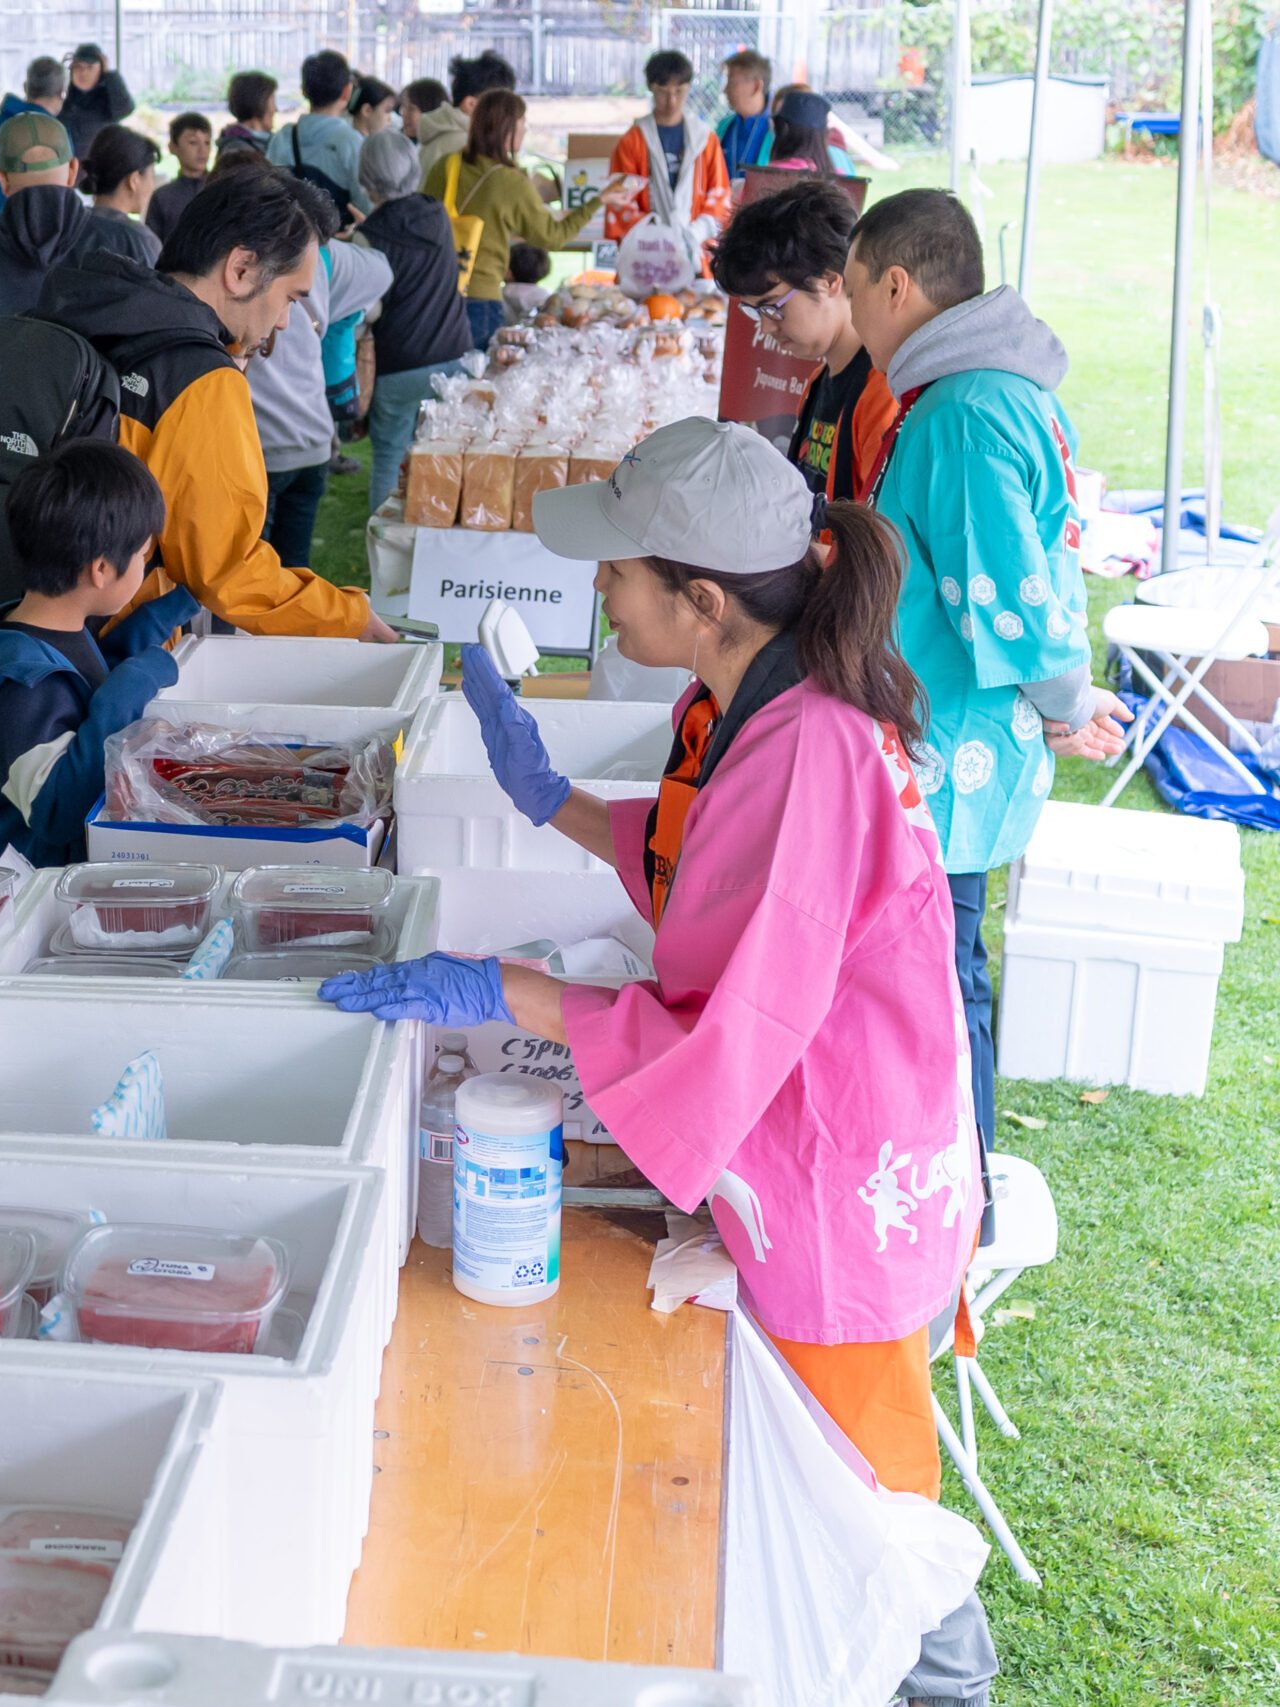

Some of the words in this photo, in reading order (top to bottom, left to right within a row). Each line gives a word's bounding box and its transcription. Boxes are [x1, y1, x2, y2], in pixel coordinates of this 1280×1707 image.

[440, 579, 563, 604] Parisienne
[300, 1671, 384, 1700] UNI
[410, 1678, 514, 1706] BOX
